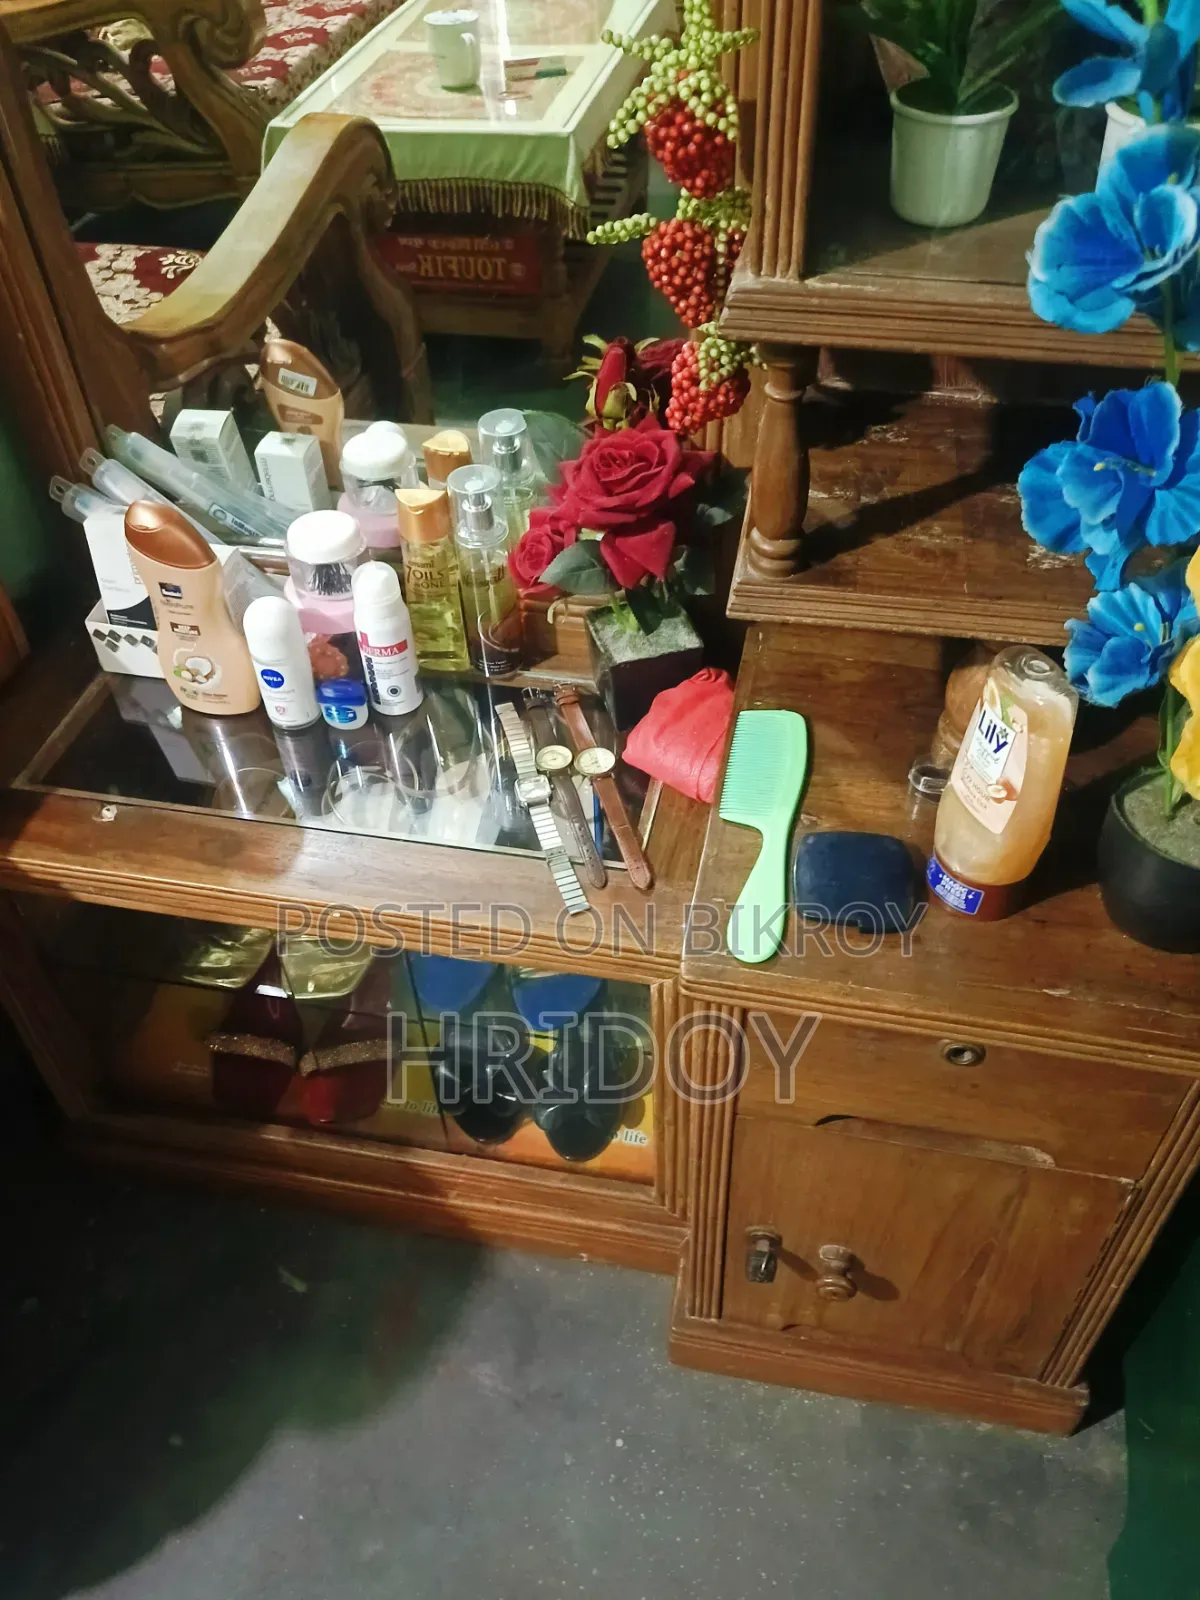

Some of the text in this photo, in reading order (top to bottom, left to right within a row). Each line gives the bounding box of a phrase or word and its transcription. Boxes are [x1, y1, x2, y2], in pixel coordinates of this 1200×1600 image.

[412, 569, 445, 581] OILS
[362, 647, 399, 657] DERMA
[262, 674, 283, 682] NIVEA
[978, 709, 1008, 754] Lily
[624, 1130, 647, 1145] life
